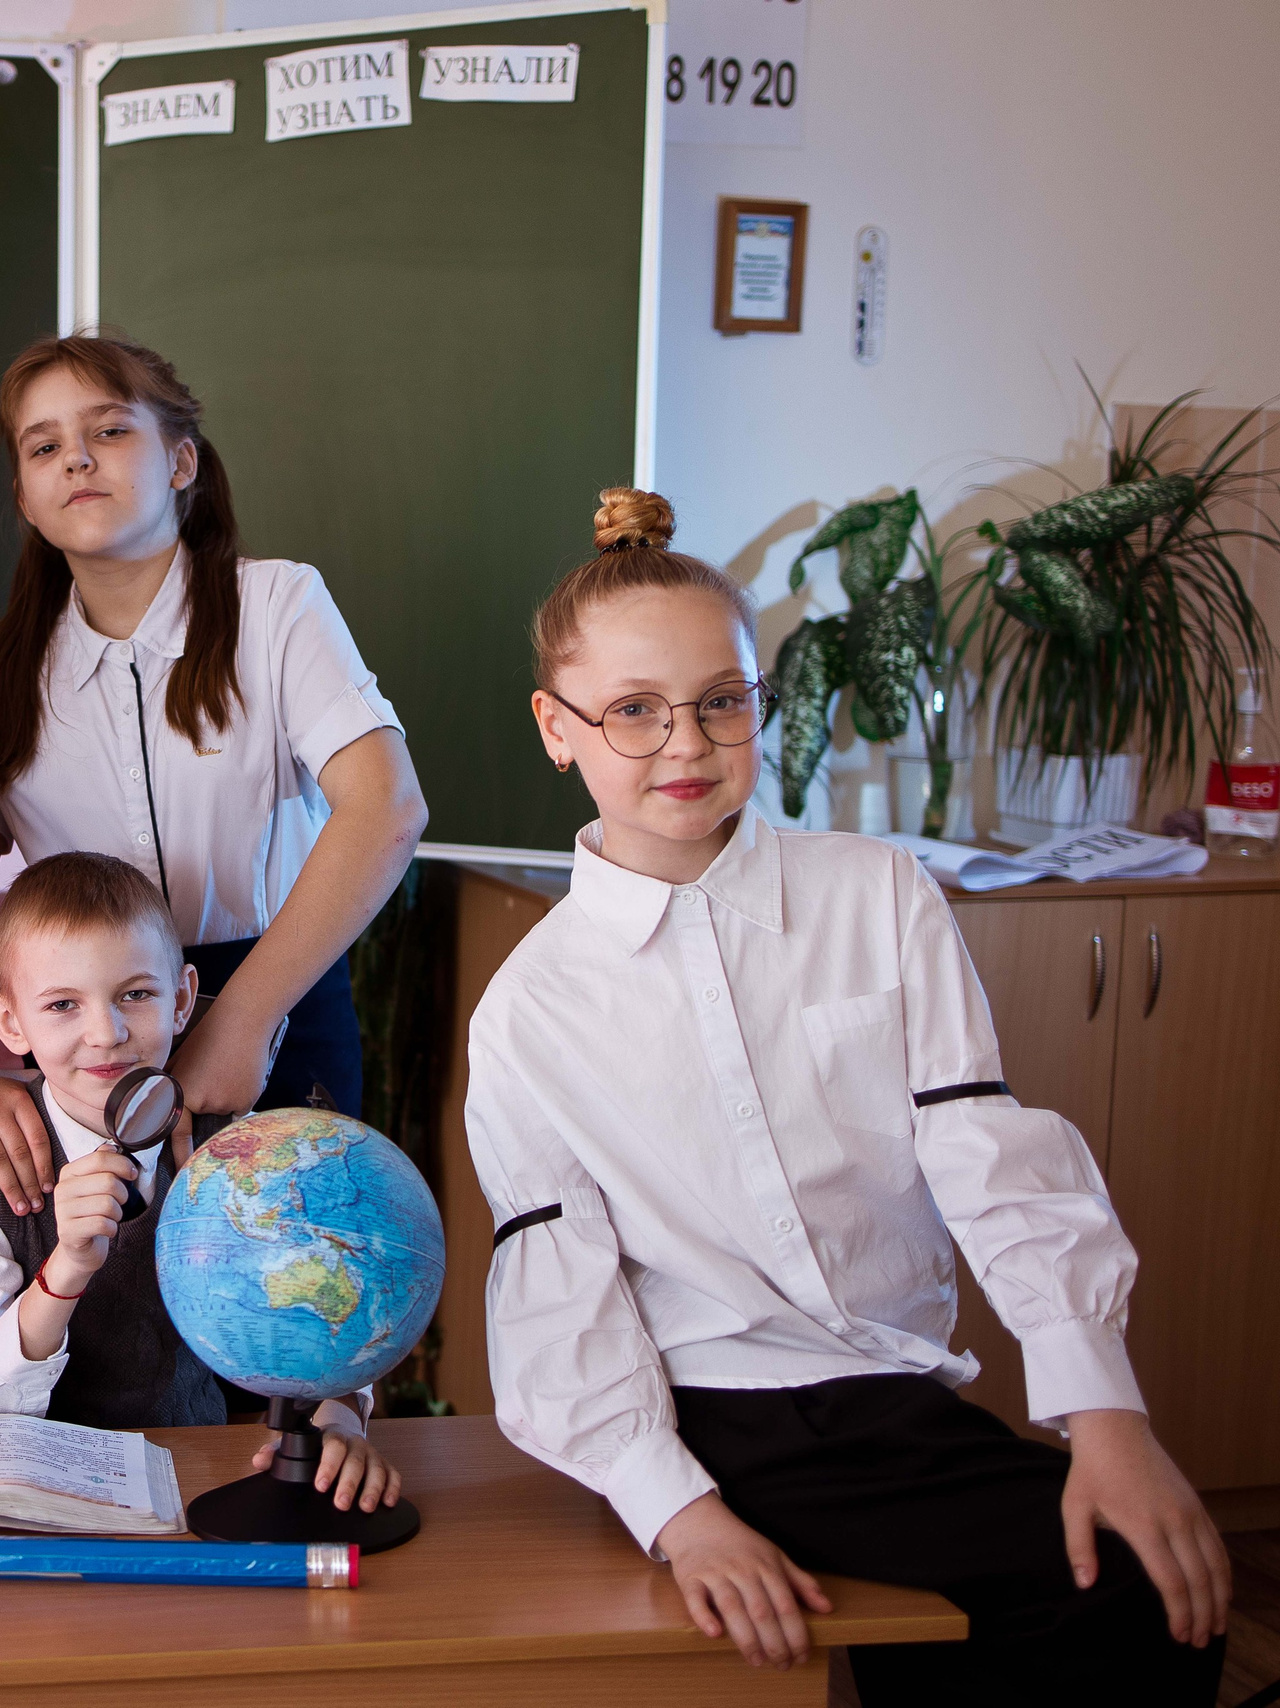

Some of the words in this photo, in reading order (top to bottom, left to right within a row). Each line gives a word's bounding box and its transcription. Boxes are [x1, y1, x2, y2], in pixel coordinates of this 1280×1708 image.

[277, 51, 394, 94] ХОТИМ
[432, 56, 570, 86] УЗНАЛИ
[698, 56, 742, 106] 19
[752, 59, 797, 108] 20
[119, 92, 221, 128] ЗНАЕМ
[276, 94, 400, 134] УЗНАТЬ
